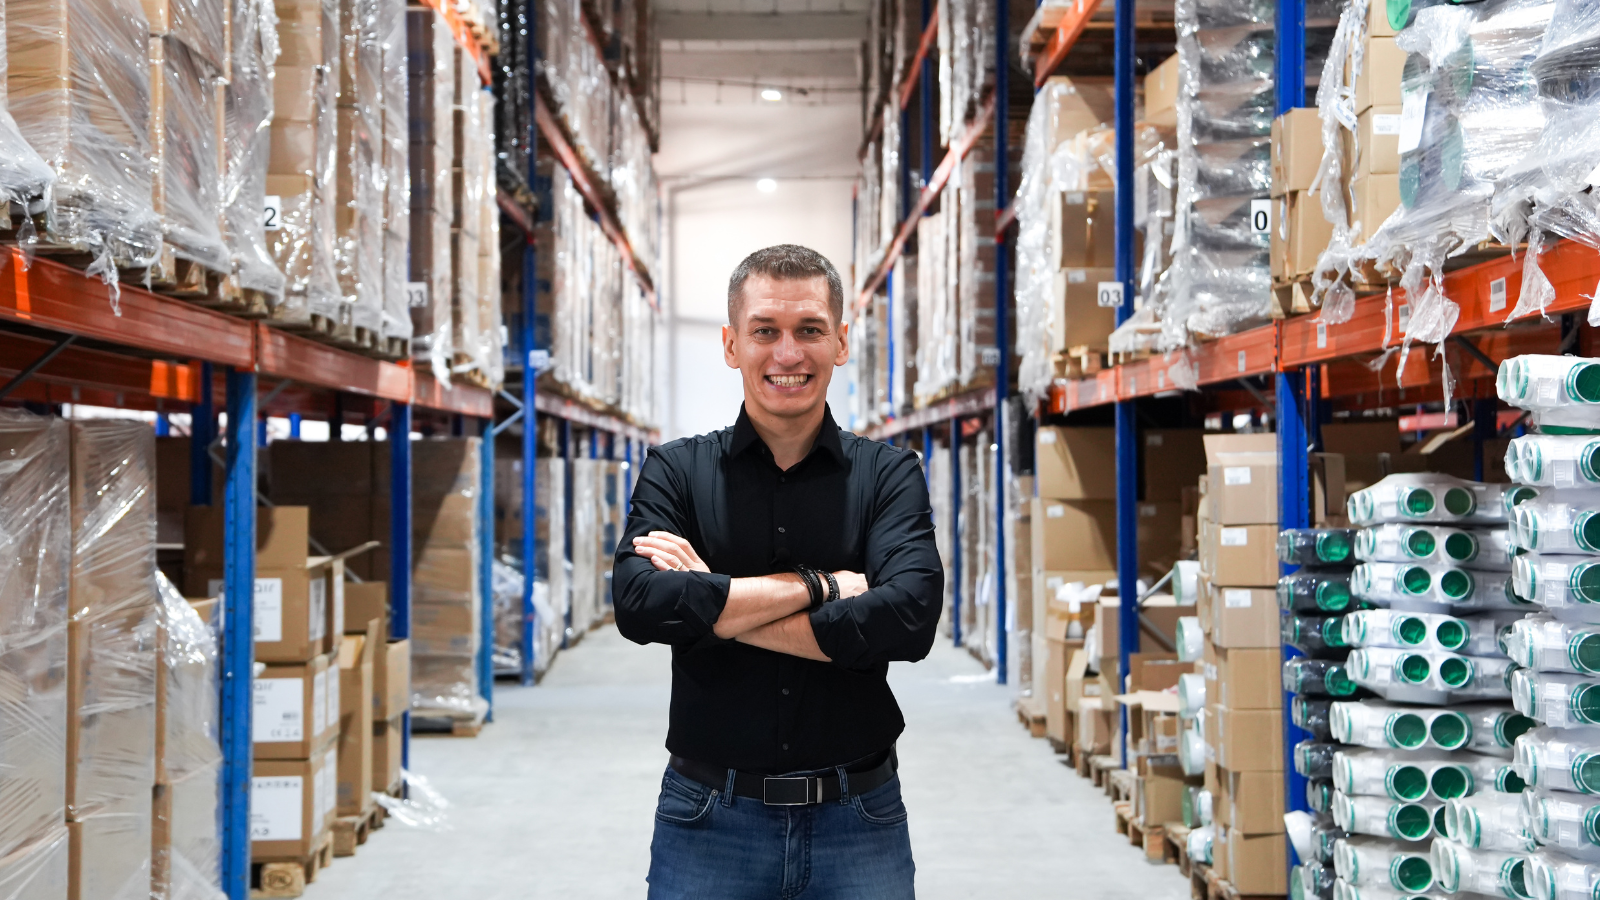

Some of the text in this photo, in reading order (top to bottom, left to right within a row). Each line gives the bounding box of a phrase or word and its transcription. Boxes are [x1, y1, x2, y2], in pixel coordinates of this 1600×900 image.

[264, 207, 277, 227] 2
[1254, 210, 1268, 231] 0
[1100, 290, 1121, 306] 03
